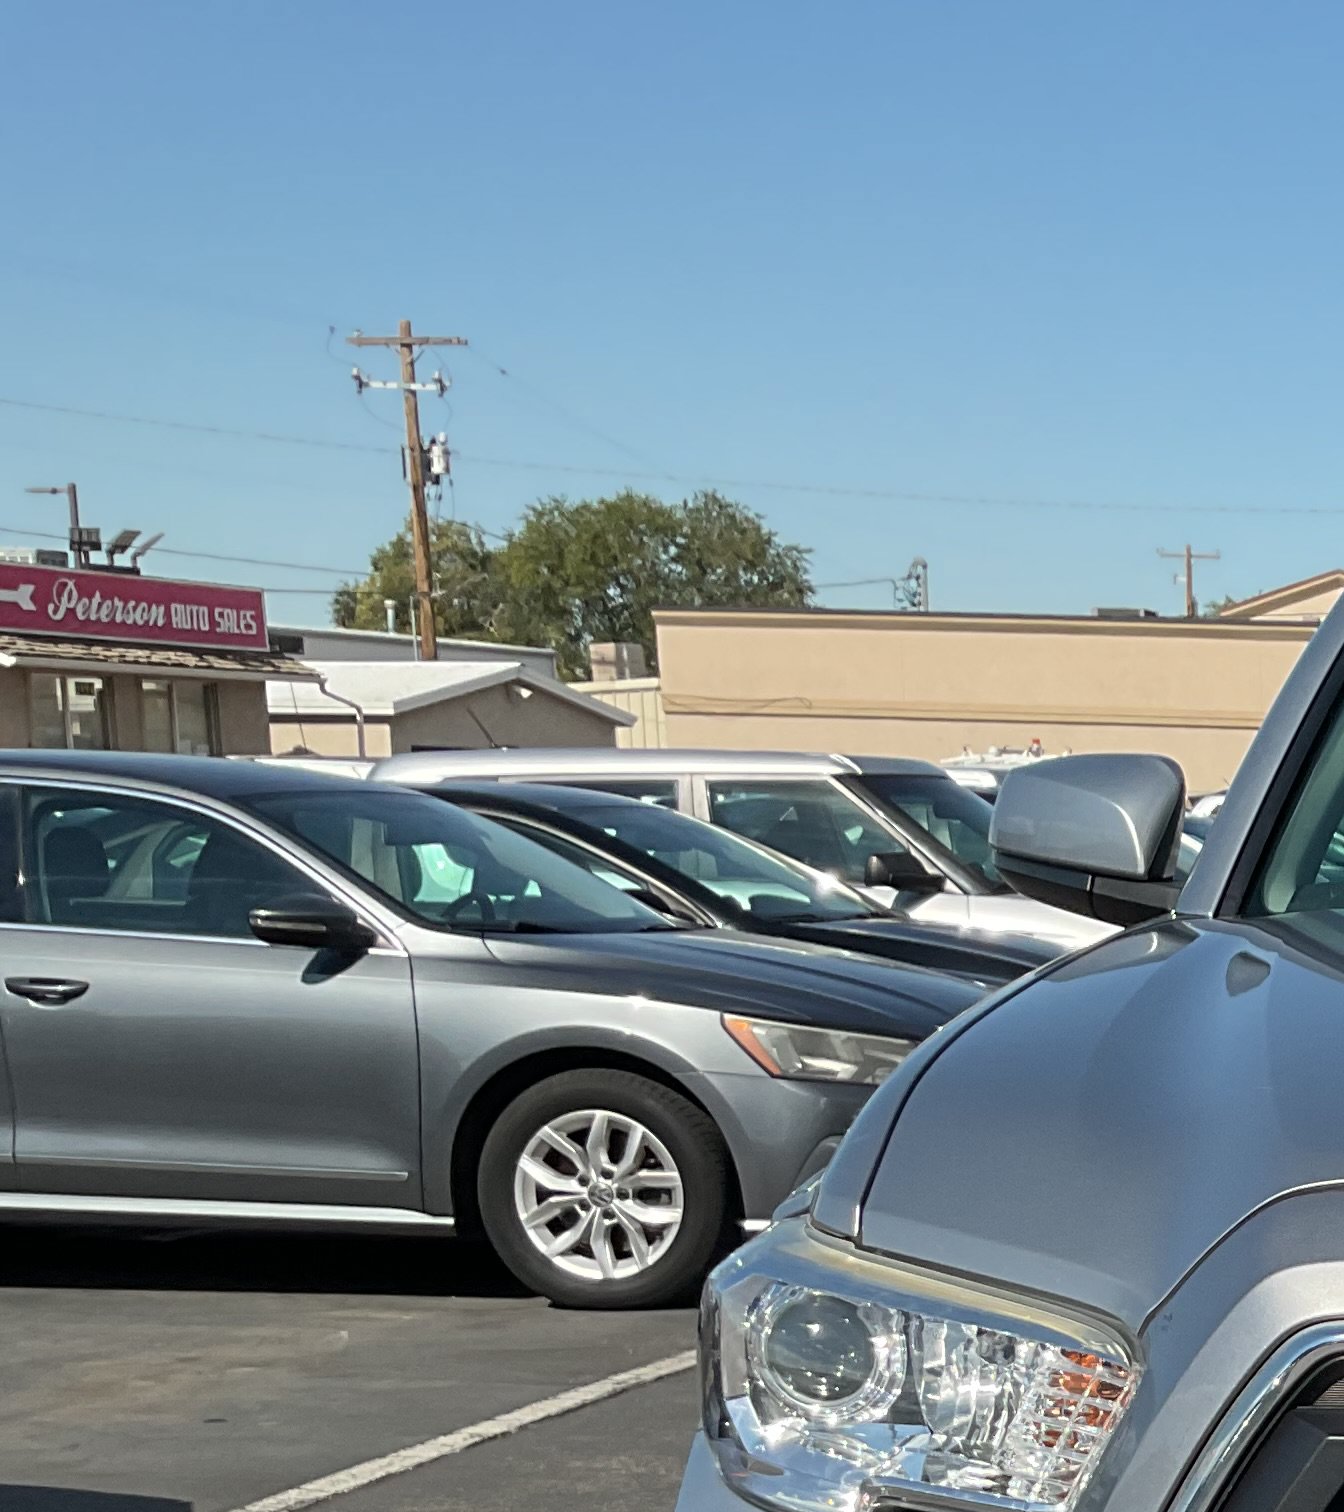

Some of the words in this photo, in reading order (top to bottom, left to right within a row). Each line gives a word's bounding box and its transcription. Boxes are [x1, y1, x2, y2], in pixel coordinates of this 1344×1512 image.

[48, 578, 166, 627] Peterson
[170, 602, 210, 632] AUTO
[214, 606, 257, 636] SALES
